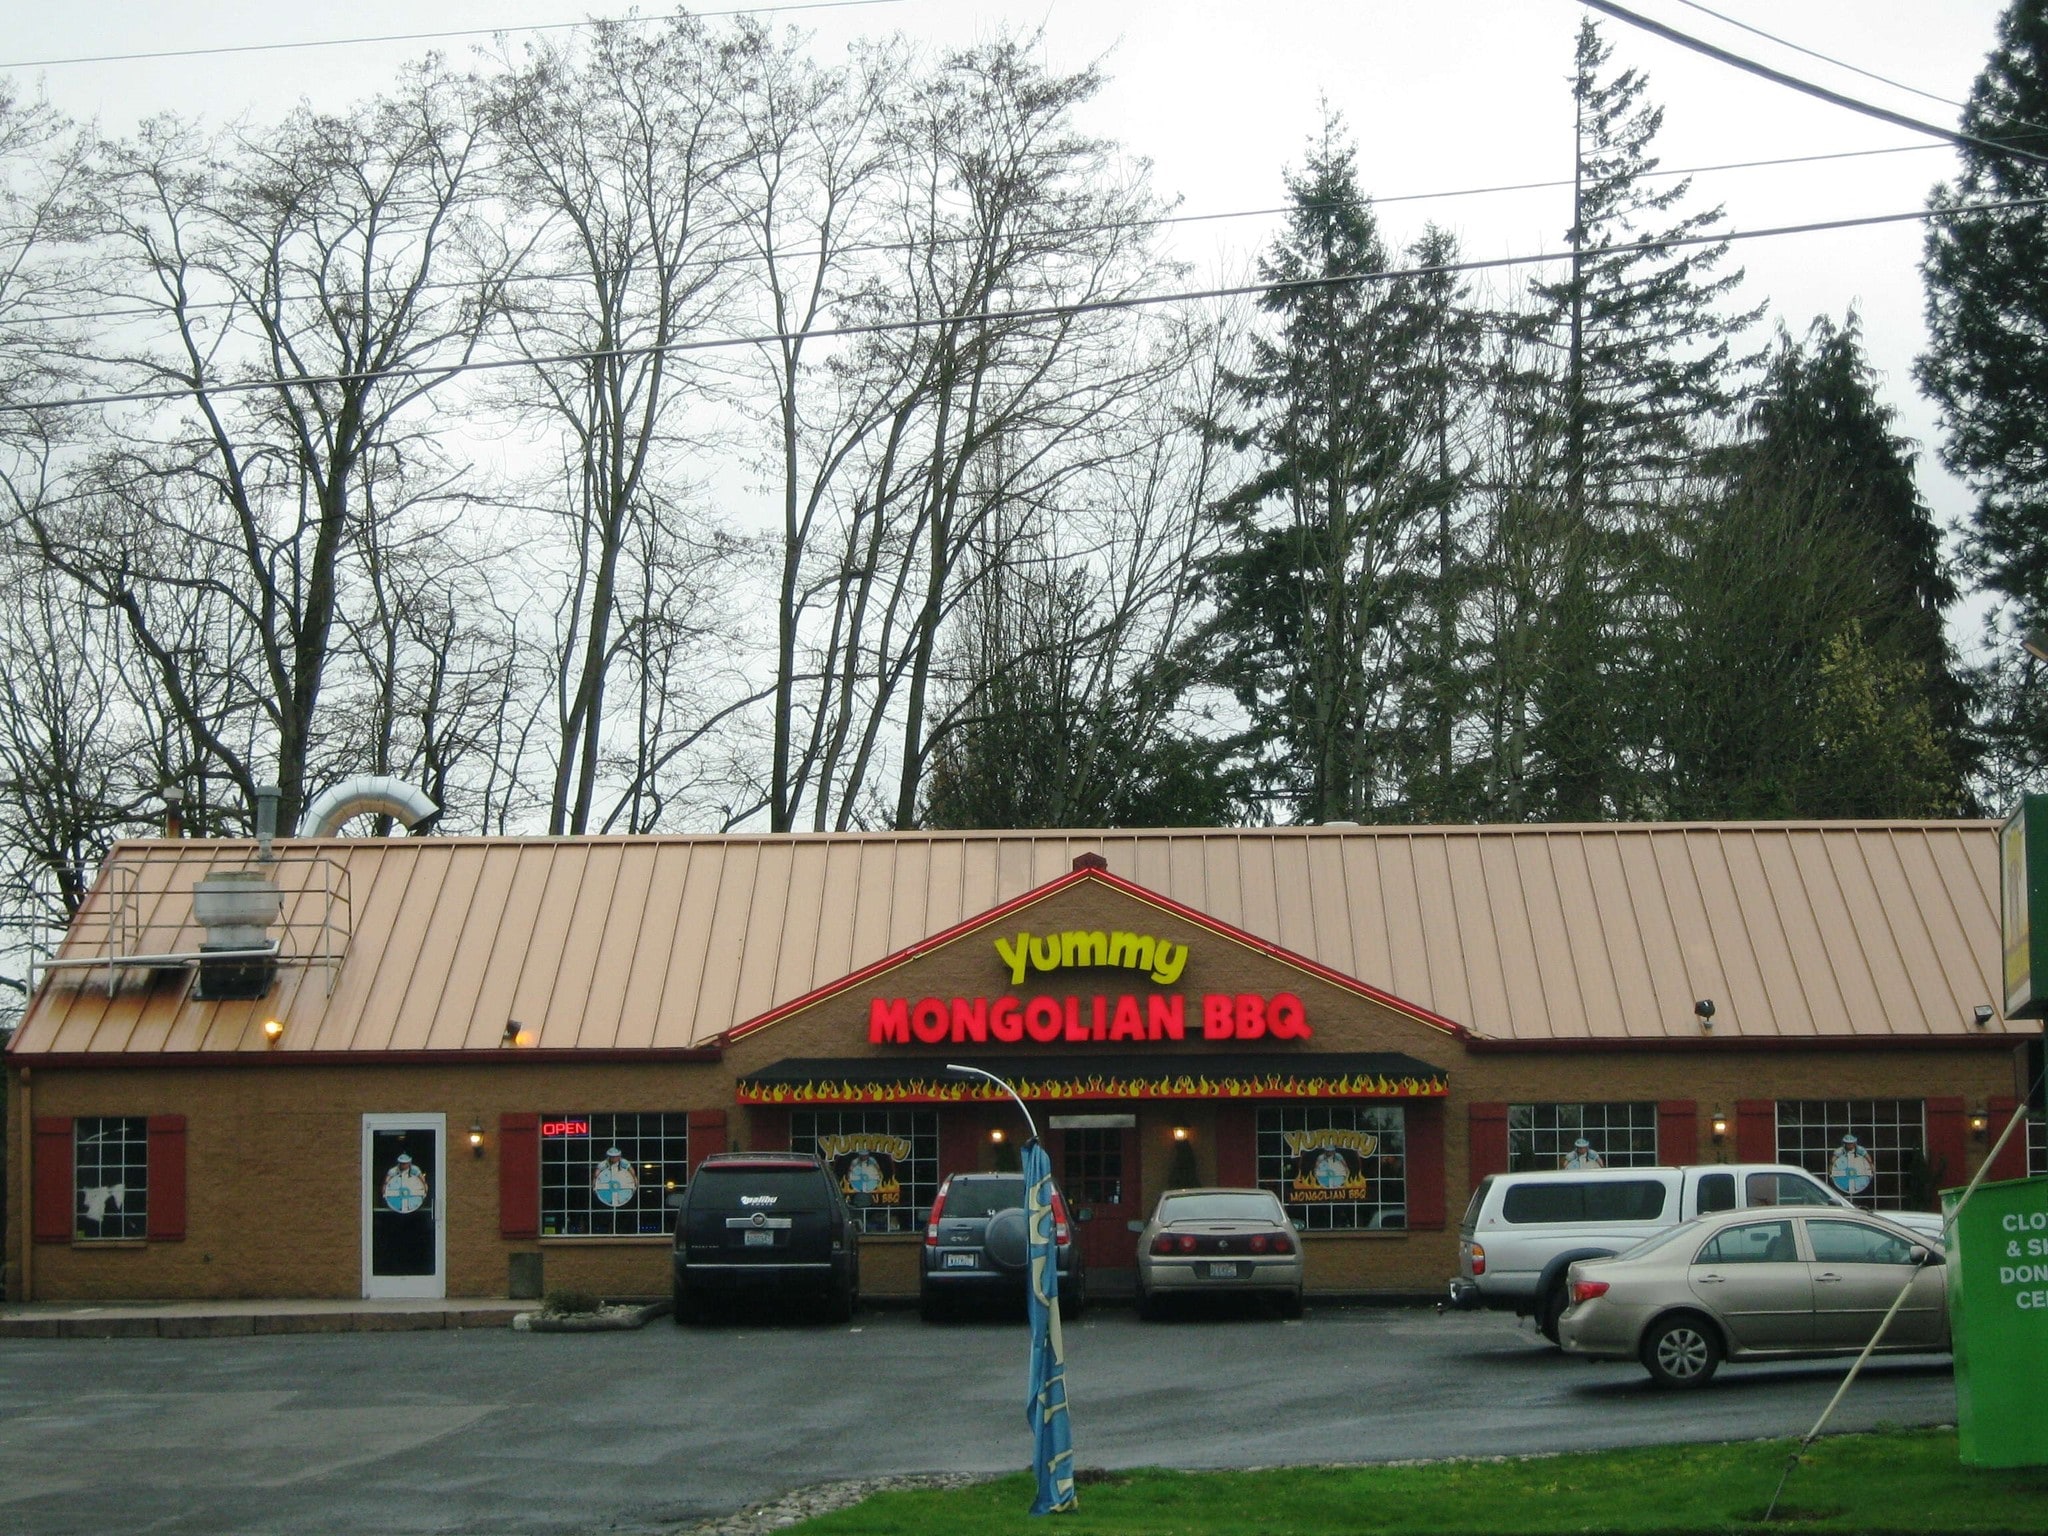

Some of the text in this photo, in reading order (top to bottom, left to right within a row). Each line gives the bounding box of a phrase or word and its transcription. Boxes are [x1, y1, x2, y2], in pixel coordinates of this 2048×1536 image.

[993, 930, 1188, 985] yummy
[867, 992, 1314, 1044] MONGOLIAN BBQ
[543, 1122, 587, 1135] OPEN
[1290, 1190, 1346, 1202] MONGOLIAN
[2002, 1212, 2048, 1232] CLO
[2006, 1240, 2022, 1257] &
[2016, 1290, 2048, 1309] CE
